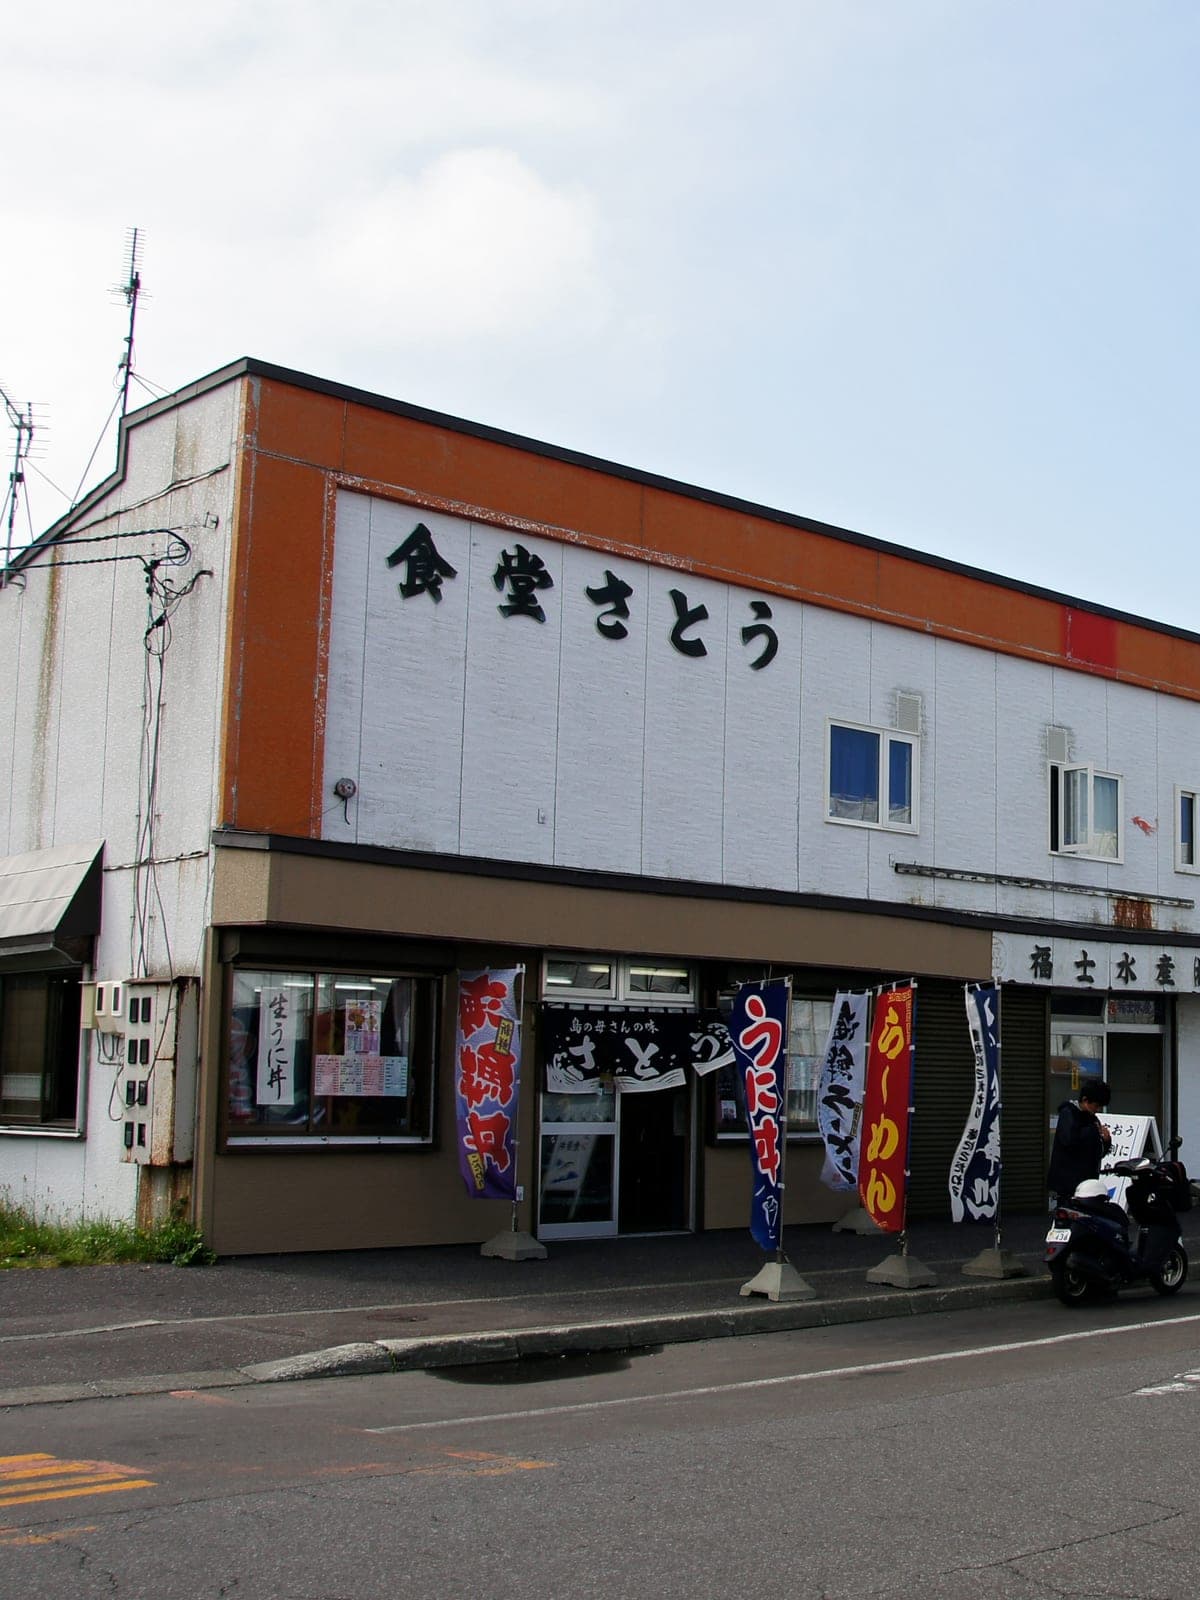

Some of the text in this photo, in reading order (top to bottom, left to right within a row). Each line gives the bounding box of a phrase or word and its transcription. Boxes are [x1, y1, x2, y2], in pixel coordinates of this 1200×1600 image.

[386, 523, 779, 670] 食堂さとう
[268, 992, 289, 1100] 生うに丼
[569, 1017, 660, 1034] 島の母さんの味
[739, 994, 782, 1186] うに丼
[867, 1006, 905, 1214] らーめん
